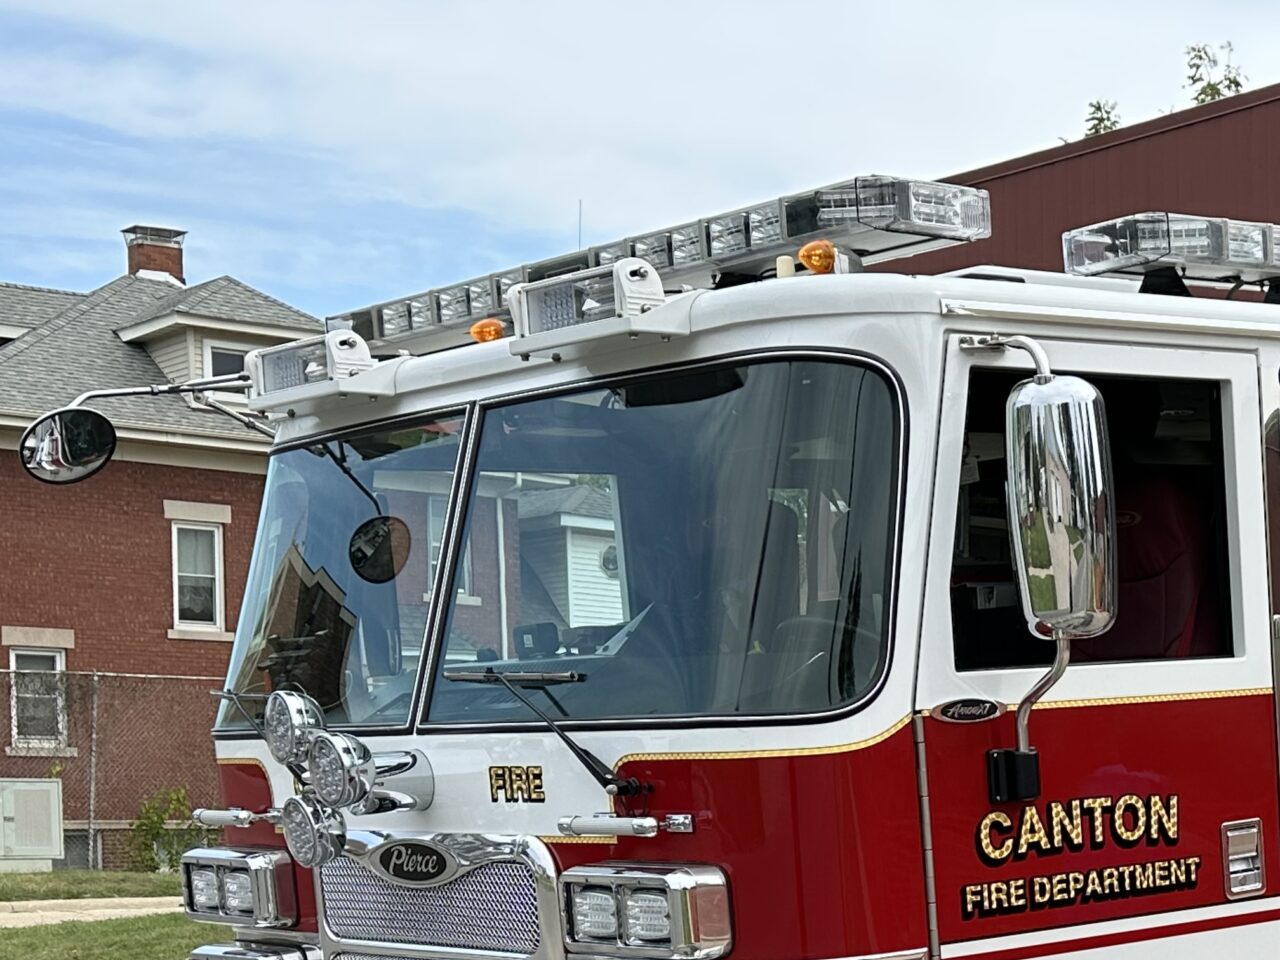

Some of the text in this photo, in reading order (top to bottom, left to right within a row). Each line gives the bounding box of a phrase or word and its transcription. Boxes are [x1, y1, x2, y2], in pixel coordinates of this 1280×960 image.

[488, 766, 545, 802] FIRE
[978, 794, 1178, 862] CANTON
[388, 845, 438, 875] Pierce
[963, 857, 1200, 915] FIRE DEPARTMENT
